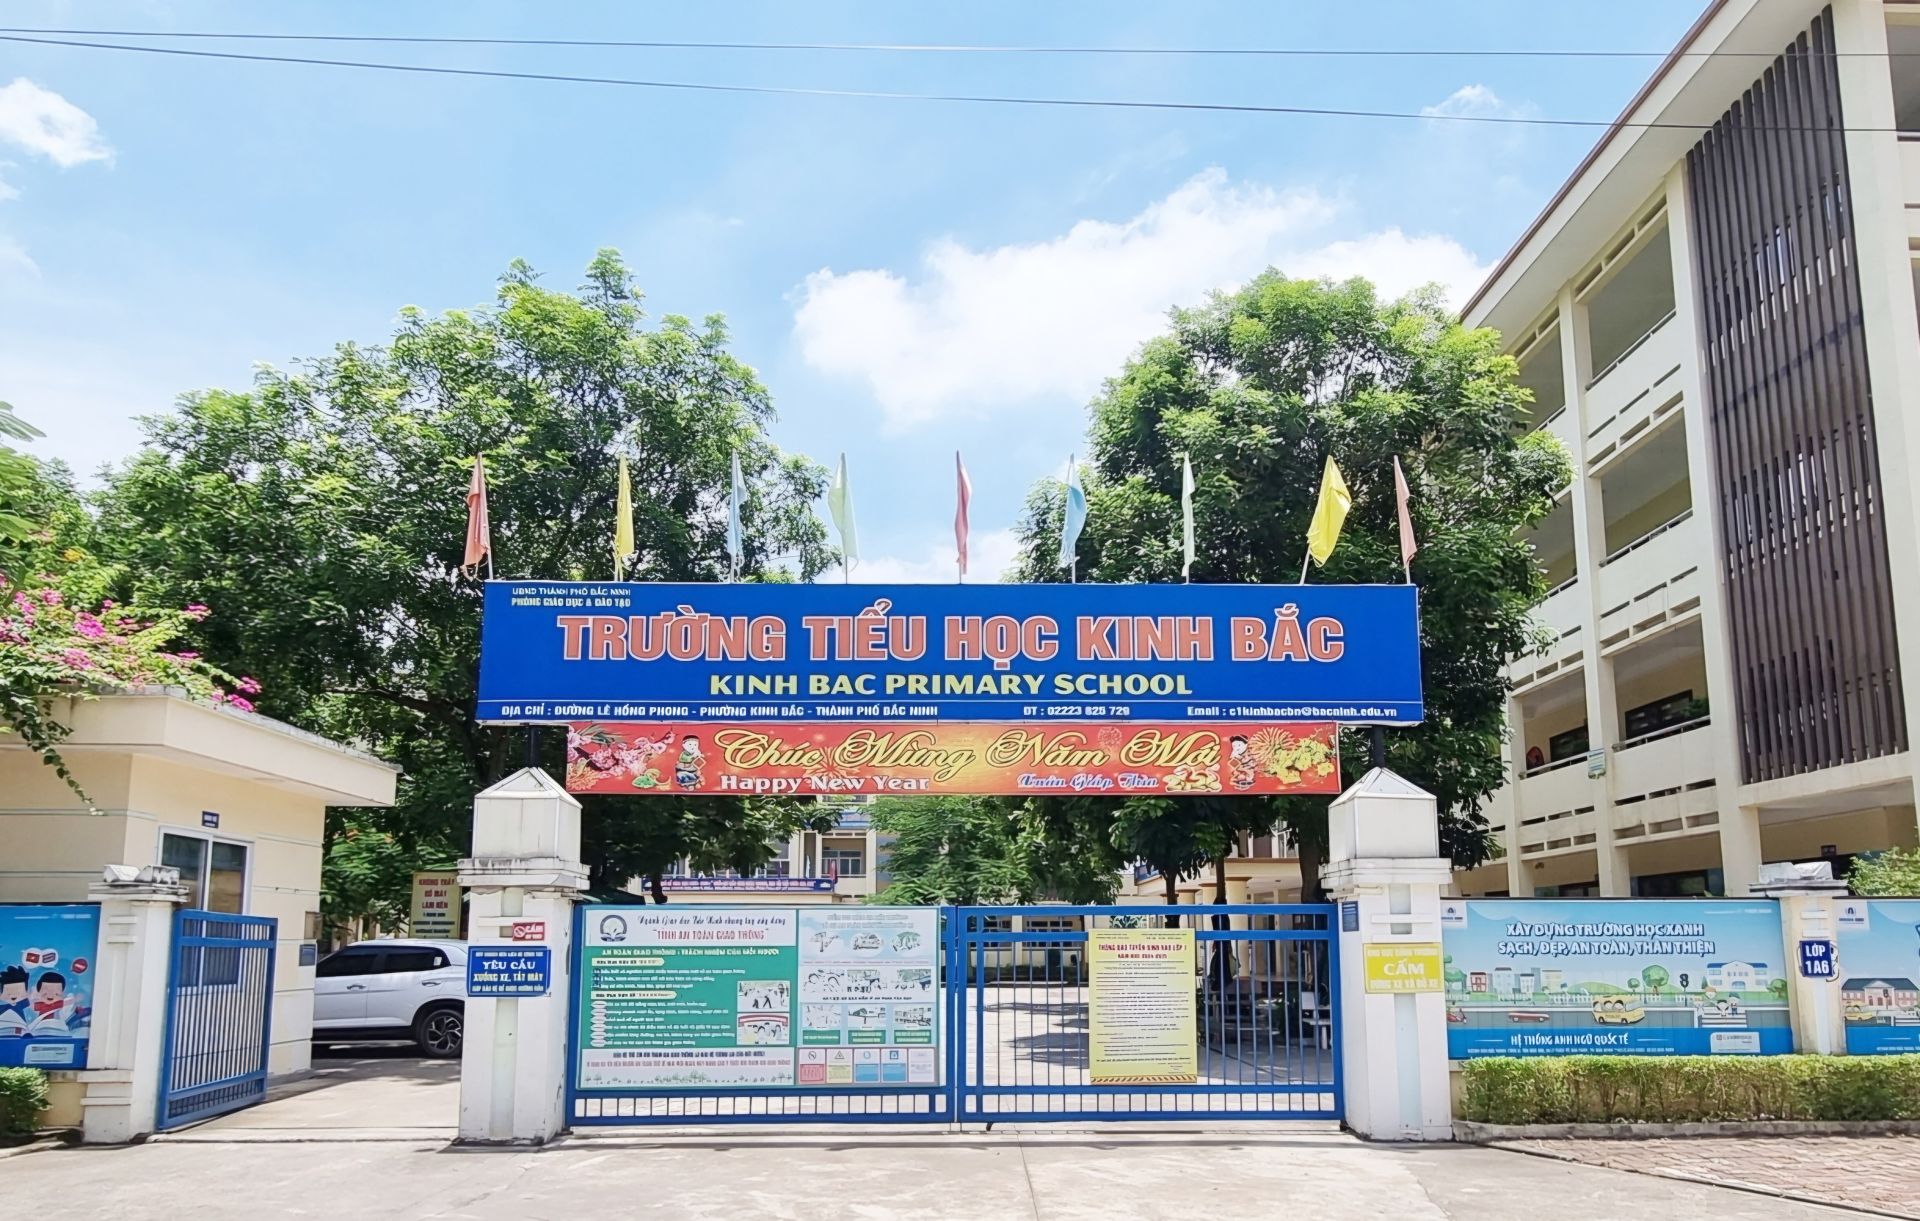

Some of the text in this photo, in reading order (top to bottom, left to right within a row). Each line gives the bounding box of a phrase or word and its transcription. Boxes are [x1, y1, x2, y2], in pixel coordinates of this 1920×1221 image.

[557, 598, 1344, 671] TRƯỜNG TIỂU HỌC KINH BẮC
[709, 674, 1192, 696] KINH BAC PRIMARY SCHOOL
[750, 706, 778, 716] KINH
[910, 706, 938, 716] NINH
[1187, 706, 1220, 716] Email
[714, 728, 1222, 782] Chúc Mừng Năm Mới
[720, 774, 930, 794] Happy New Year
[1506, 922, 1704, 940] XÂY DỰNG TRƯỜNG HỌC XANH
[1572, 942, 1594, 954] AN
[1674, 940, 1716, 958] THIỆN
[1805, 942, 1826, 956] LỚP
[482, 960, 507, 970] YÊU
[1383, 958, 1424, 976] CẤM
[1805, 960, 1830, 974] 1A6
